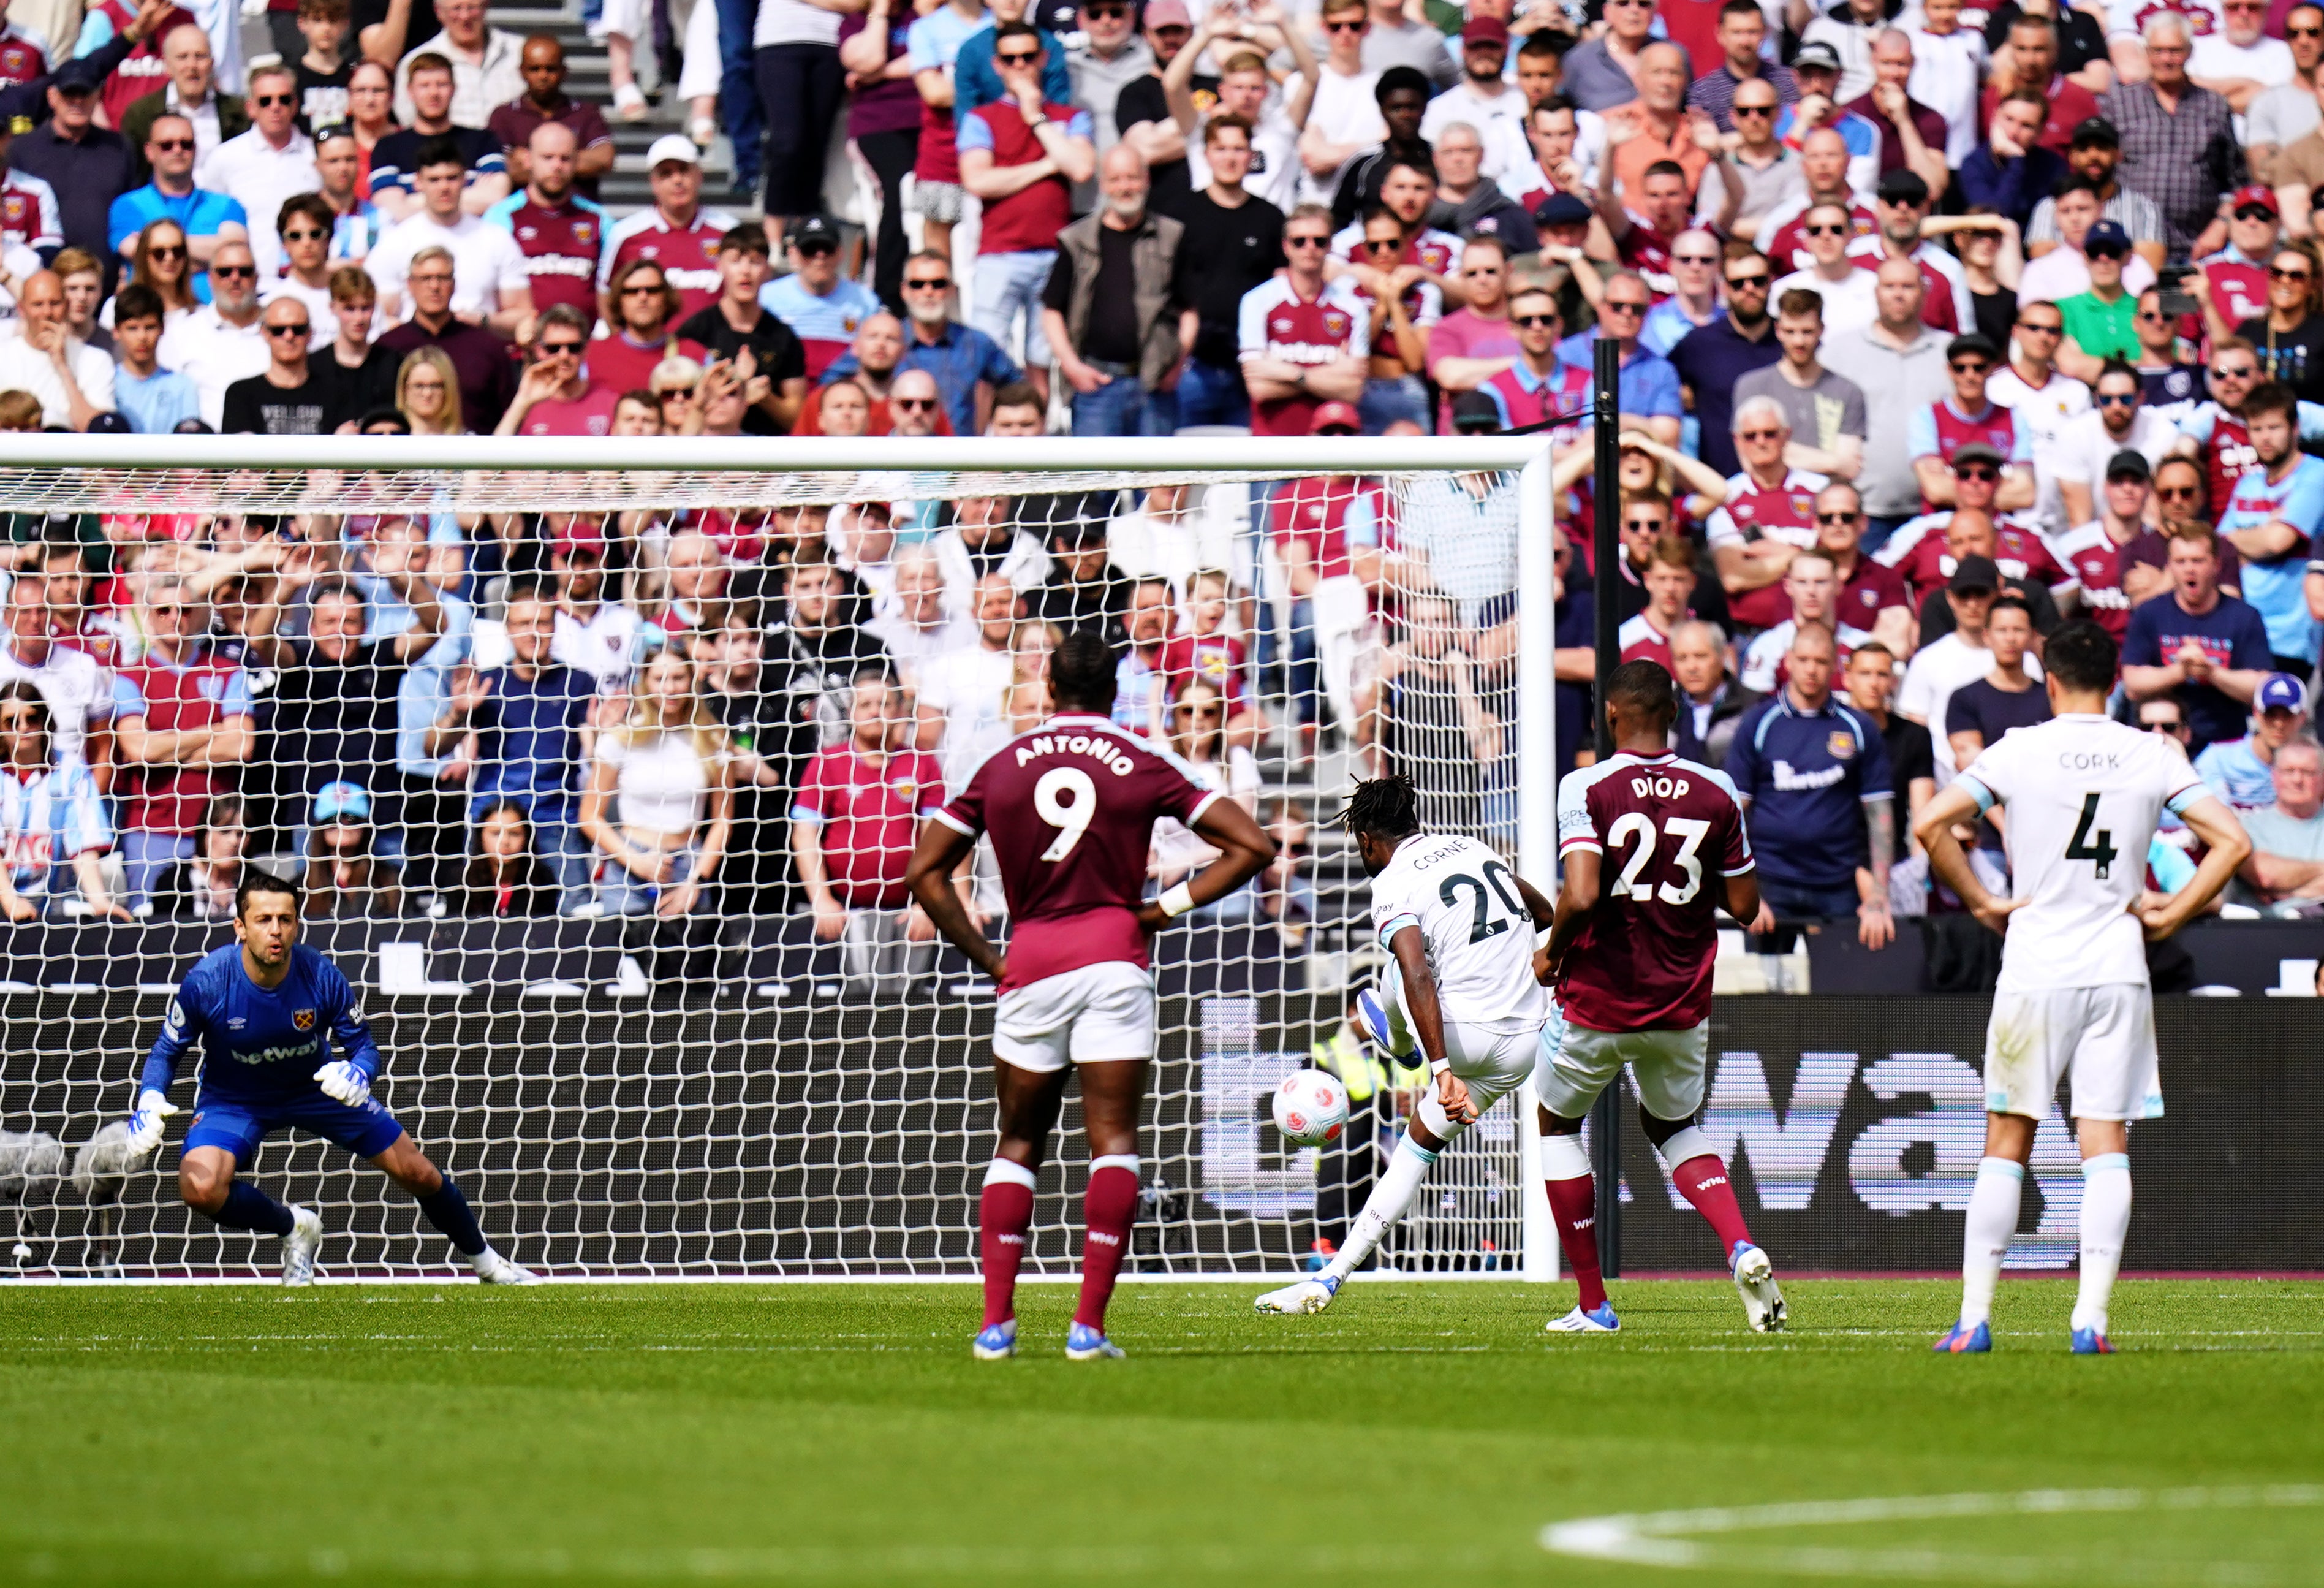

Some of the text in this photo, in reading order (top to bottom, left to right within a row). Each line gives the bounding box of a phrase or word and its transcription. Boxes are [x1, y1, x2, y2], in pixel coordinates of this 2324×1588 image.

[1015, 735, 1134, 777] ANTONIO
[2059, 753, 2120, 769] CORK
[1631, 777, 1690, 800] DIOP
[1034, 766, 1097, 862] 9
[2065, 792, 2118, 879] 4
[1414, 838, 1470, 870] CORNE
[1607, 812, 1711, 905] 23
[1440, 860, 1532, 946] 20
[231, 1036, 319, 1065] betway
[1697, 1176, 1727, 1191] WHU
[1370, 1209, 1390, 1229] BFC
